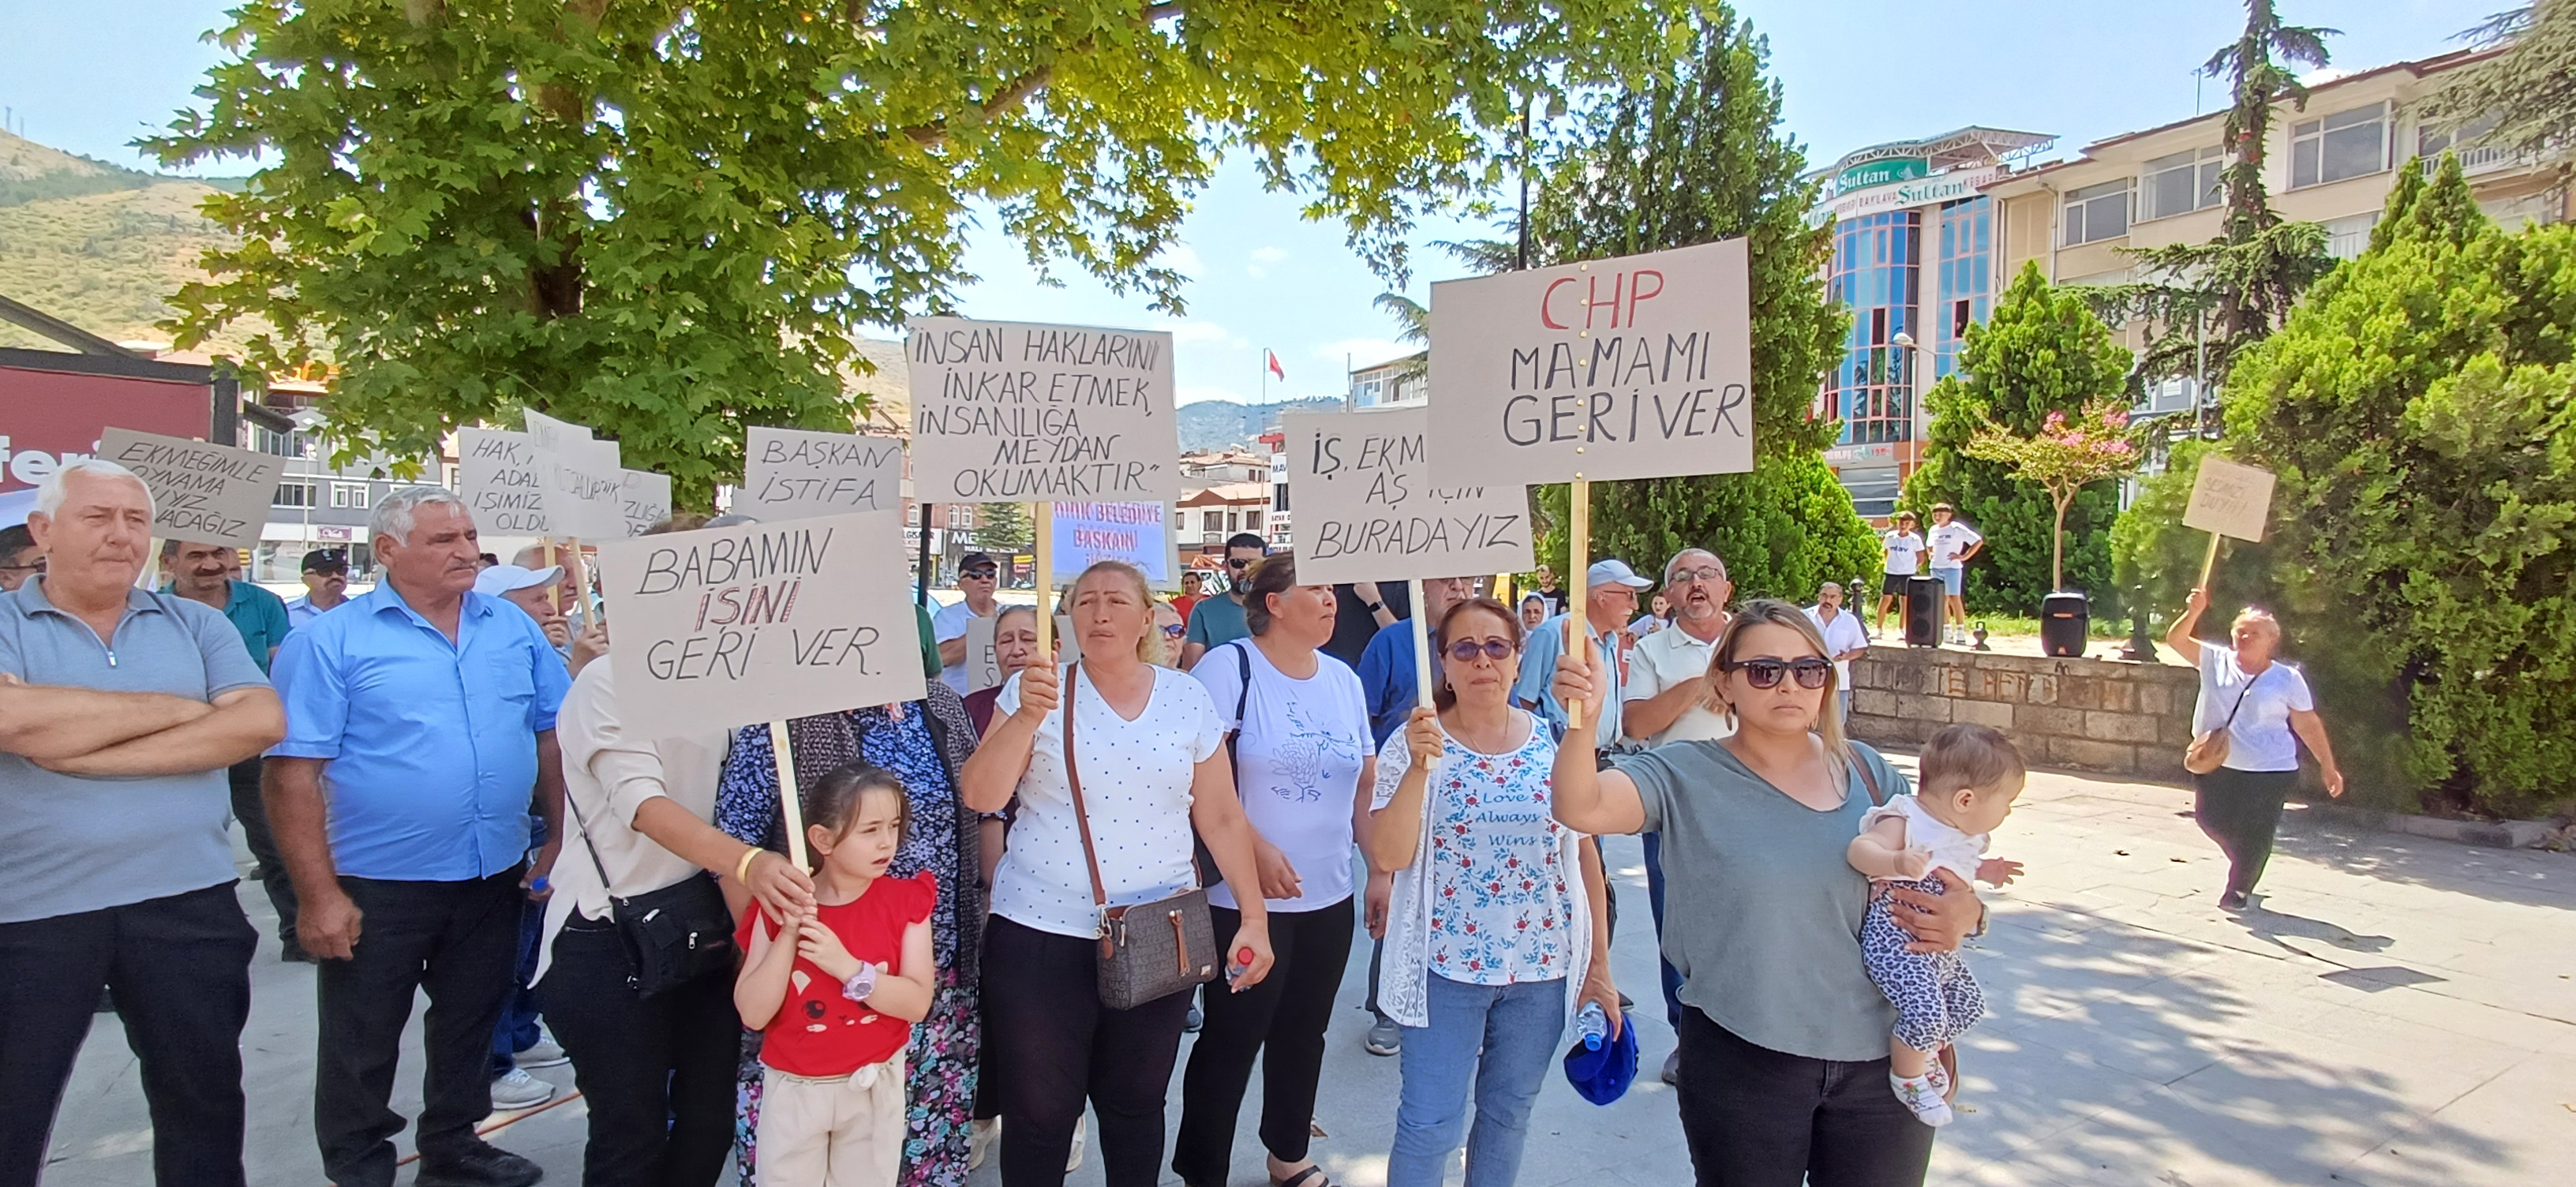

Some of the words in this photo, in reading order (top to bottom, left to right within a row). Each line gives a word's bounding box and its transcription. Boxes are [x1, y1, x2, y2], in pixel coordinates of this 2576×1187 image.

[1839, 169, 1890, 194] Sultan
[1894, 182, 1964, 205] Sultan
[1541, 270, 1664, 330] CHP
[1024, 329, 1161, 373] HAKLARINI
[1511, 331, 1709, 391] MAMAMI
[943, 367, 1040, 404] İNKAR
[1048, 373, 1152, 417] ETMEK,
[918, 404, 1081, 437] İNSANLIĞA
[118, 441, 270, 483] EKMEĞİMLE
[761, 439, 902, 469] BAŞKAN
[993, 435, 1121, 466] MEYDAN
[1357, 434, 1425, 476] EKM
[474, 487, 543, 512] İŞİMİZ
[758, 471, 878, 511] İSTİFA
[1365, 471, 1408, 511] AŞ
[1310, 513, 1520, 560] BURADAYIZ
[634, 527, 834, 595] BABAMIN
[646, 627, 759, 680] GERİ
[792, 626, 882, 676] VER.
[984, 644, 995, 665] E
[983, 666, 998, 687] S
[1483, 792, 1528, 803] Love
[1475, 811, 1541, 826] Always
[1488, 834, 1538, 846] Wins
